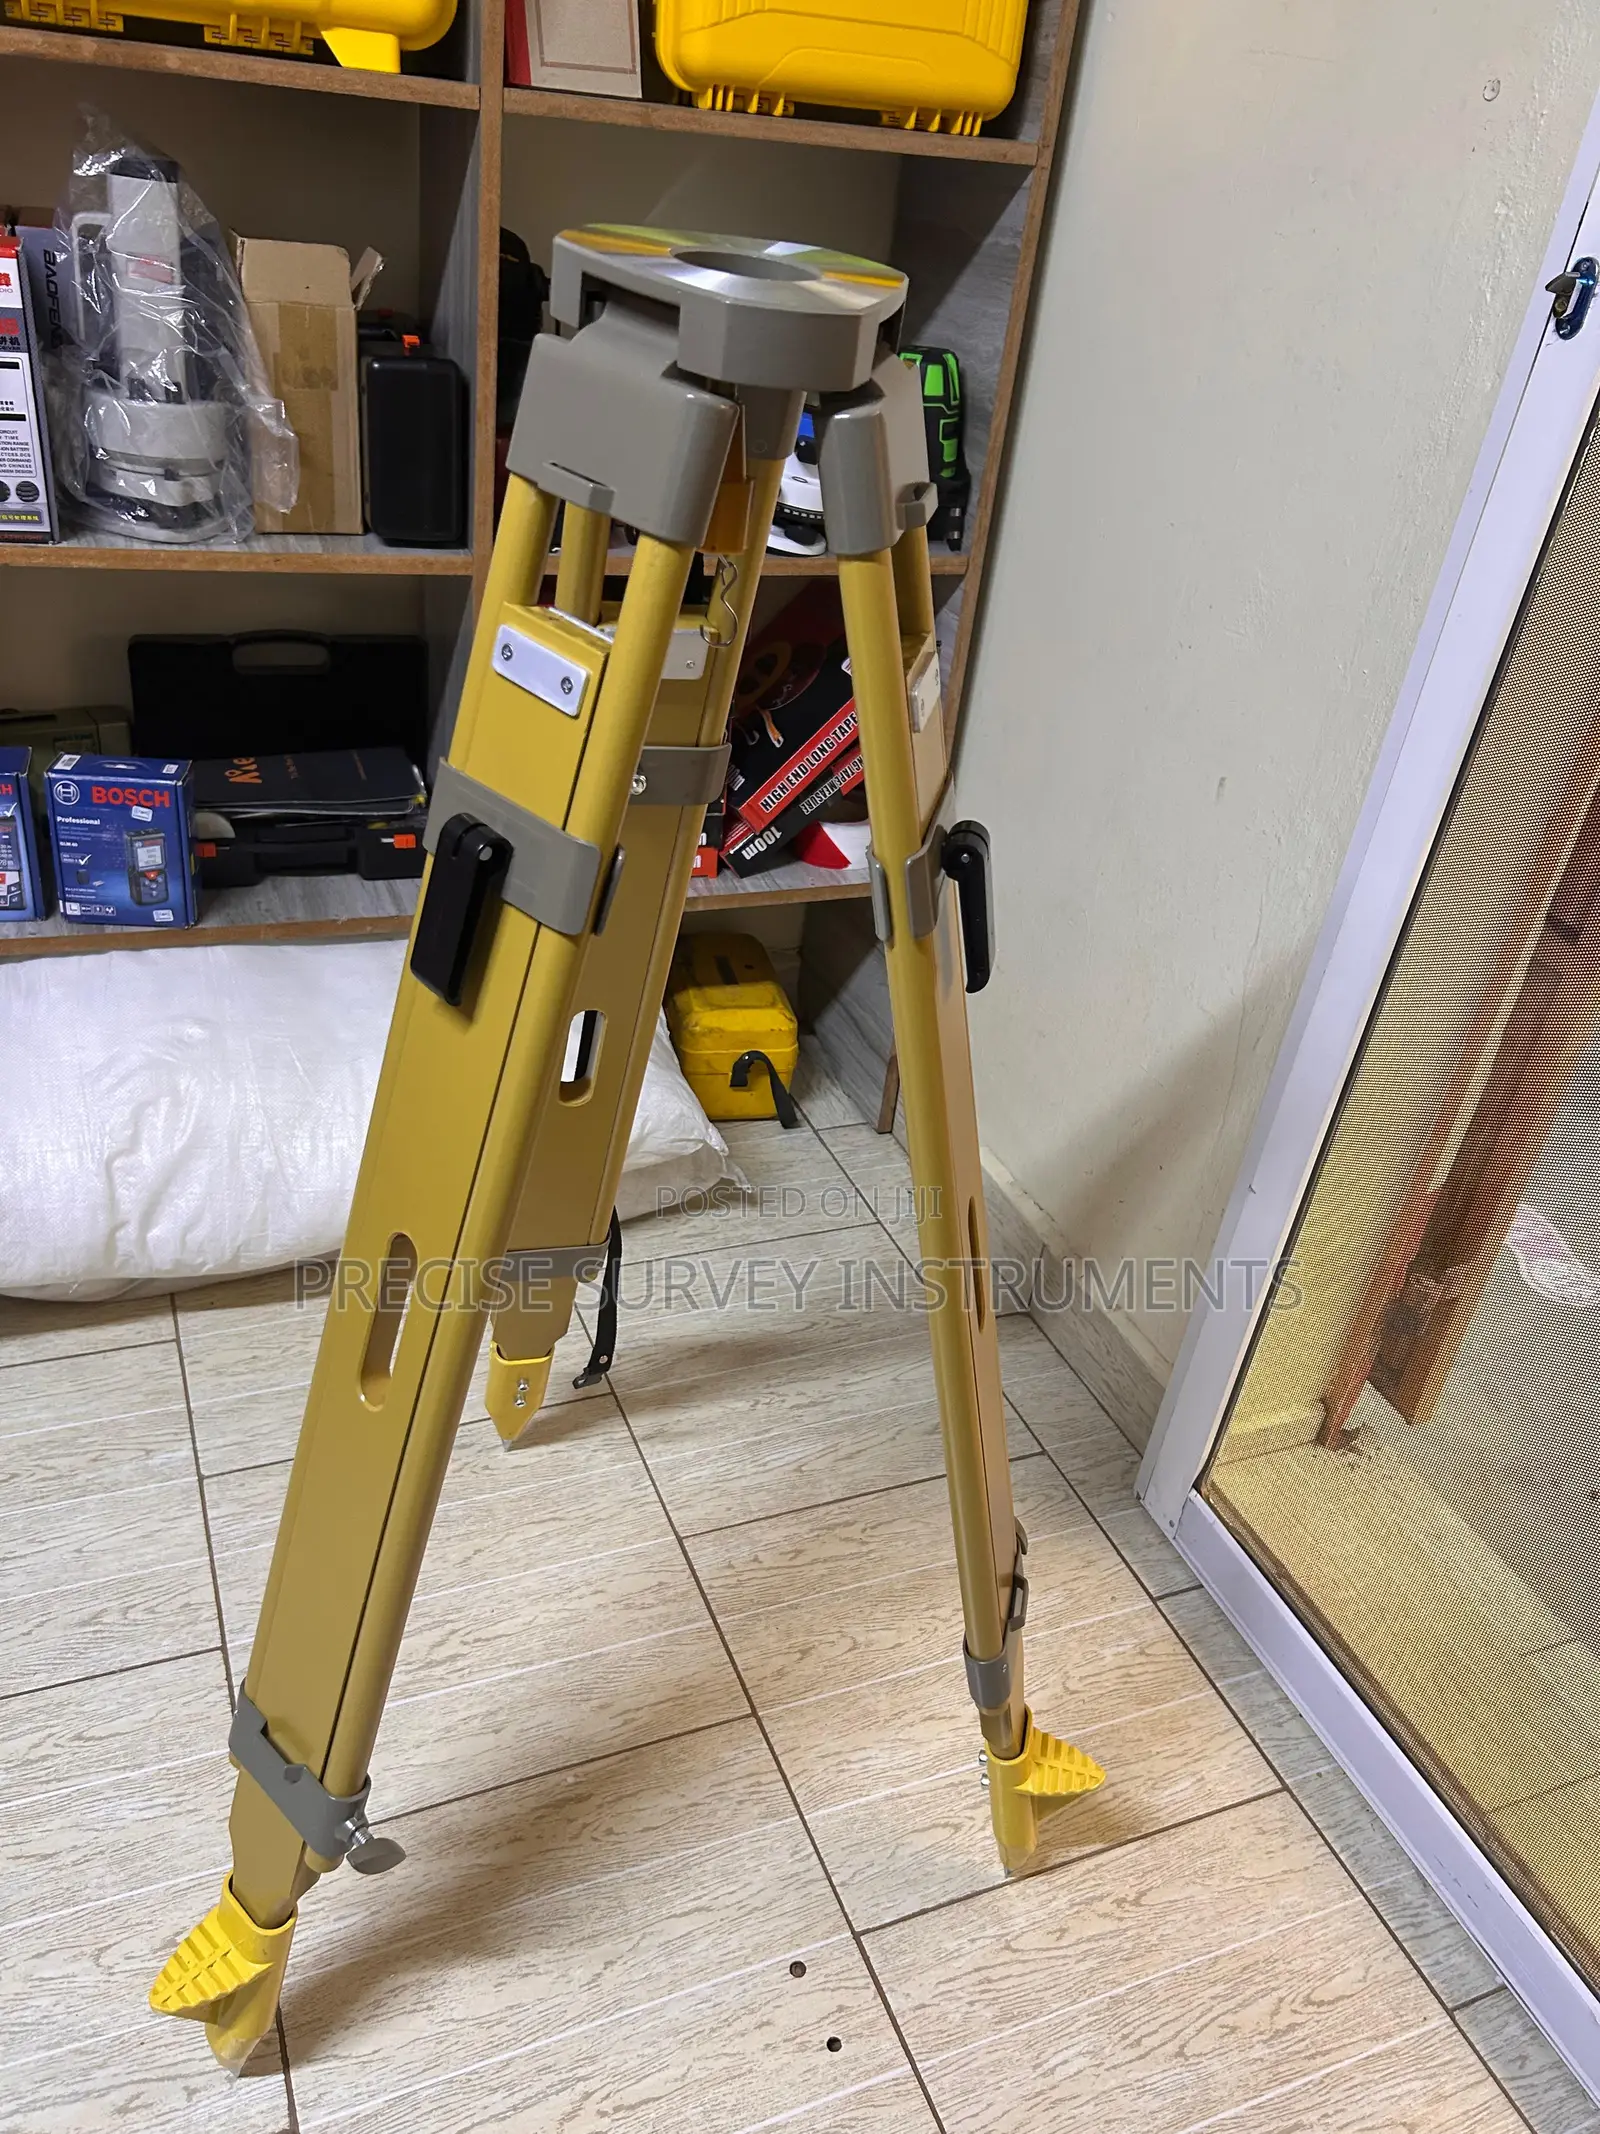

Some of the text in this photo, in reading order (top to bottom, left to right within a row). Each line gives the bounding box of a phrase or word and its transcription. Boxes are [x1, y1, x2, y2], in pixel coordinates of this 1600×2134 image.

[760, 782, 791, 813] HIGH
[785, 762, 811, 789] END
[804, 736, 838, 769] LONG
[92, 786, 170, 808] BOSCH
[800, 777, 839, 815] MEASURE
[57, 816, 100, 825] Professional
[741, 826, 782, 860] 100m
